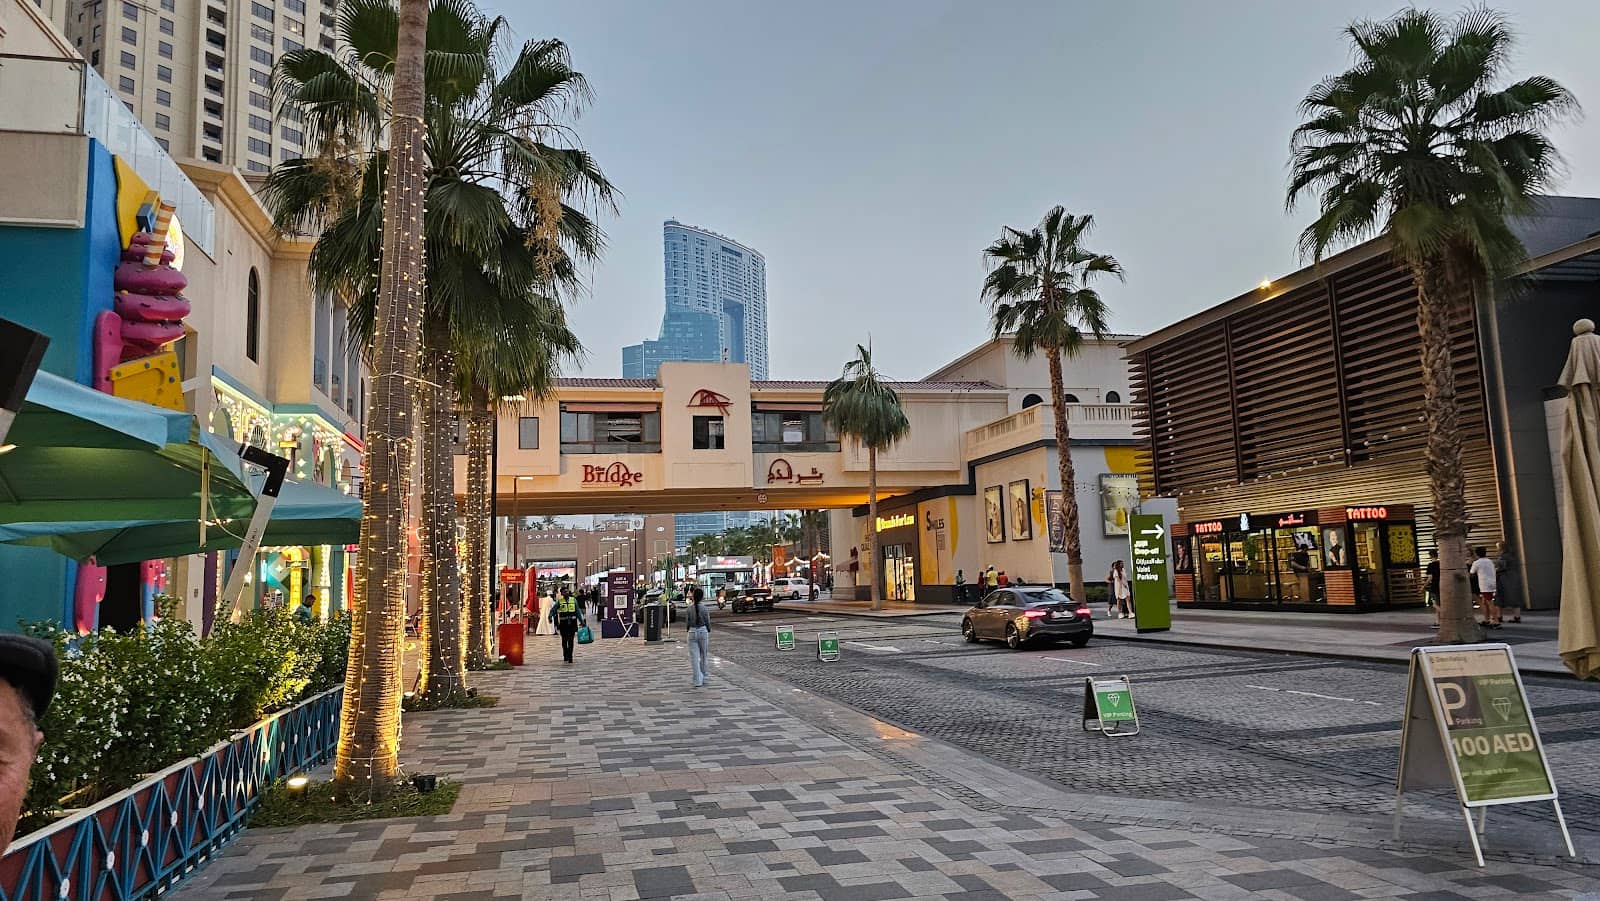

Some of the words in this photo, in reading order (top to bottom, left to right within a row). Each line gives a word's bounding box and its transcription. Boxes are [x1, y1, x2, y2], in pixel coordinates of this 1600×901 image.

[582, 462, 642, 486] Bridge
[1346, 507, 1388, 520] TATTOO
[1195, 521, 1223, 534] TATTOO
[1436, 683, 1466, 725] P
[1452, 735, 1490, 757] 100
[1494, 732, 1534, 753] AED
